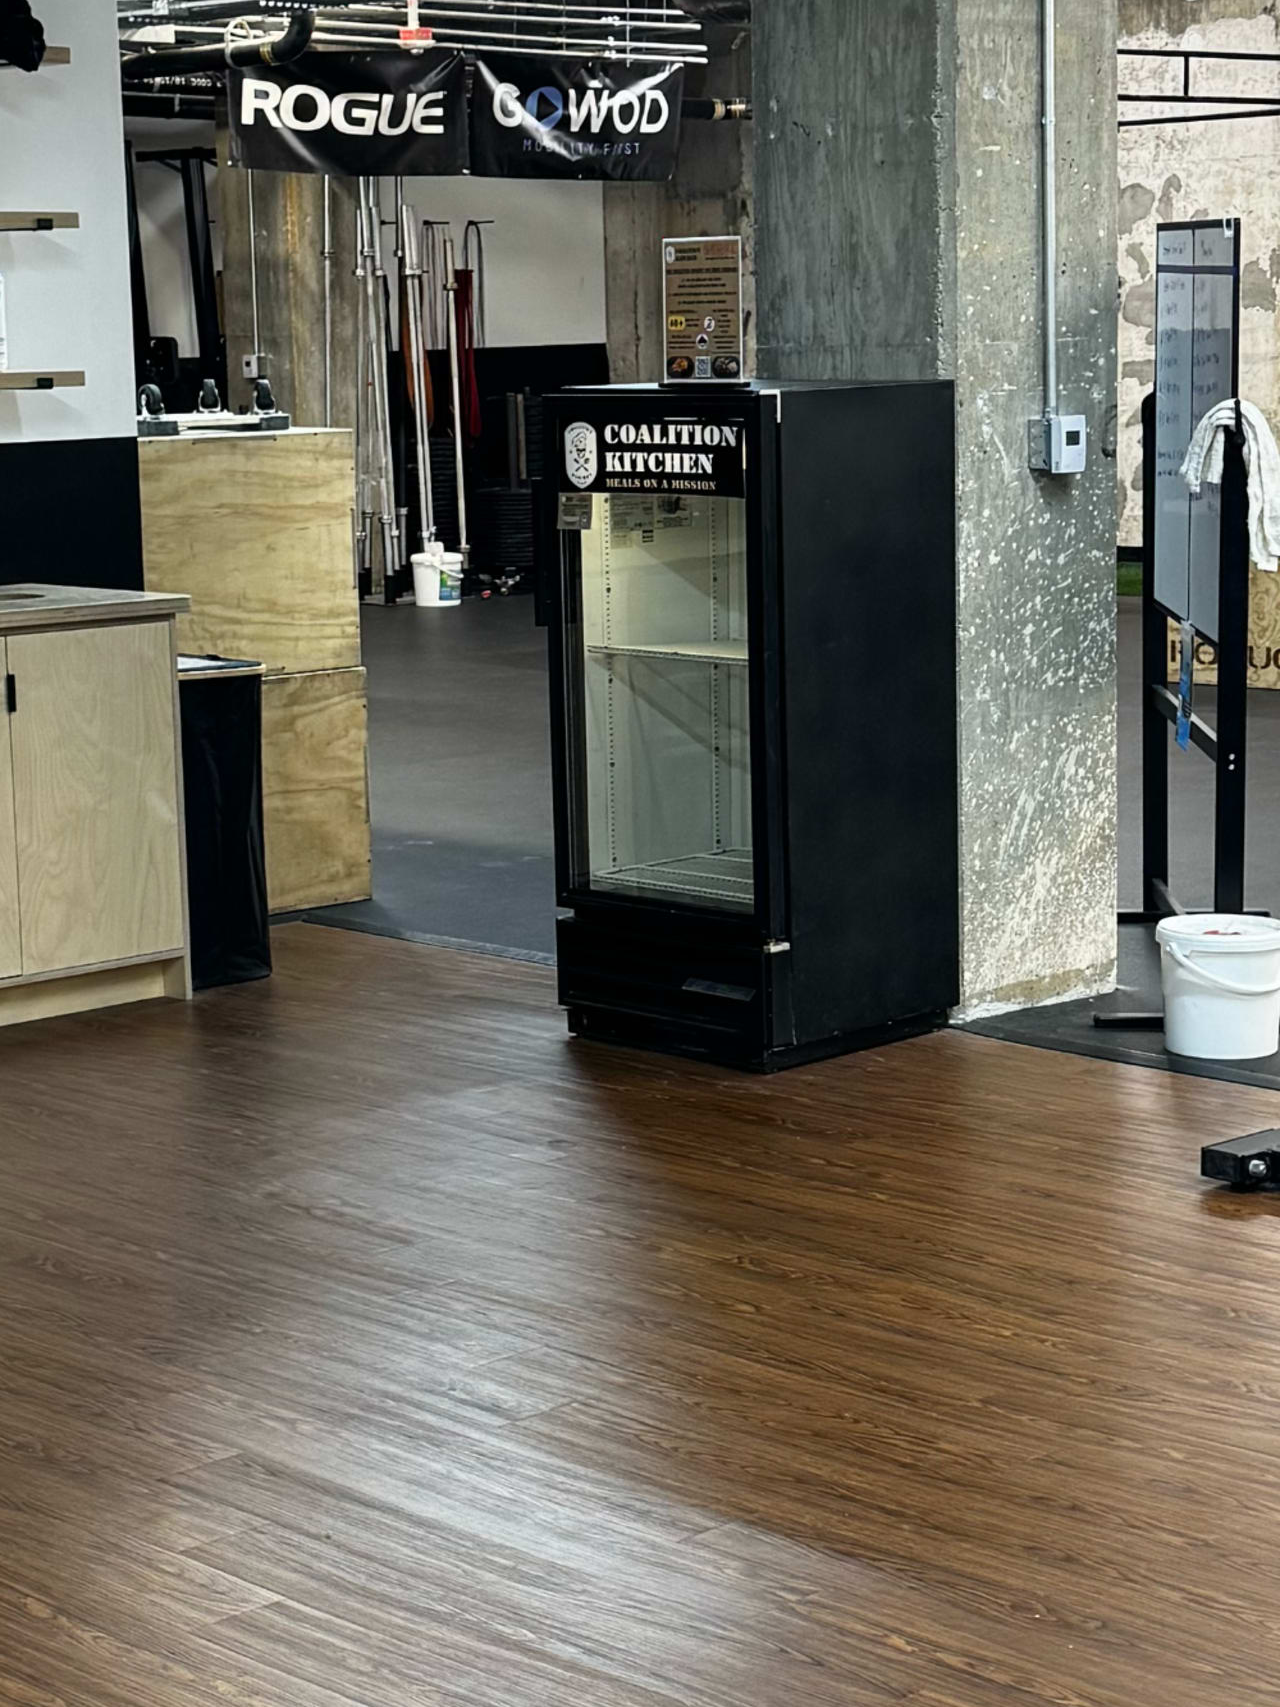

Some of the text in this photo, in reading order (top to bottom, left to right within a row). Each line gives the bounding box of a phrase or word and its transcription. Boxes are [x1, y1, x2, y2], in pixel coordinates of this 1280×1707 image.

[240, 78, 445, 136] ROGUE
[604, 424, 738, 447] COALITION
[604, 451, 714, 474] KITCHEN
[606, 478, 716, 490] MEALS ON A MISSION
